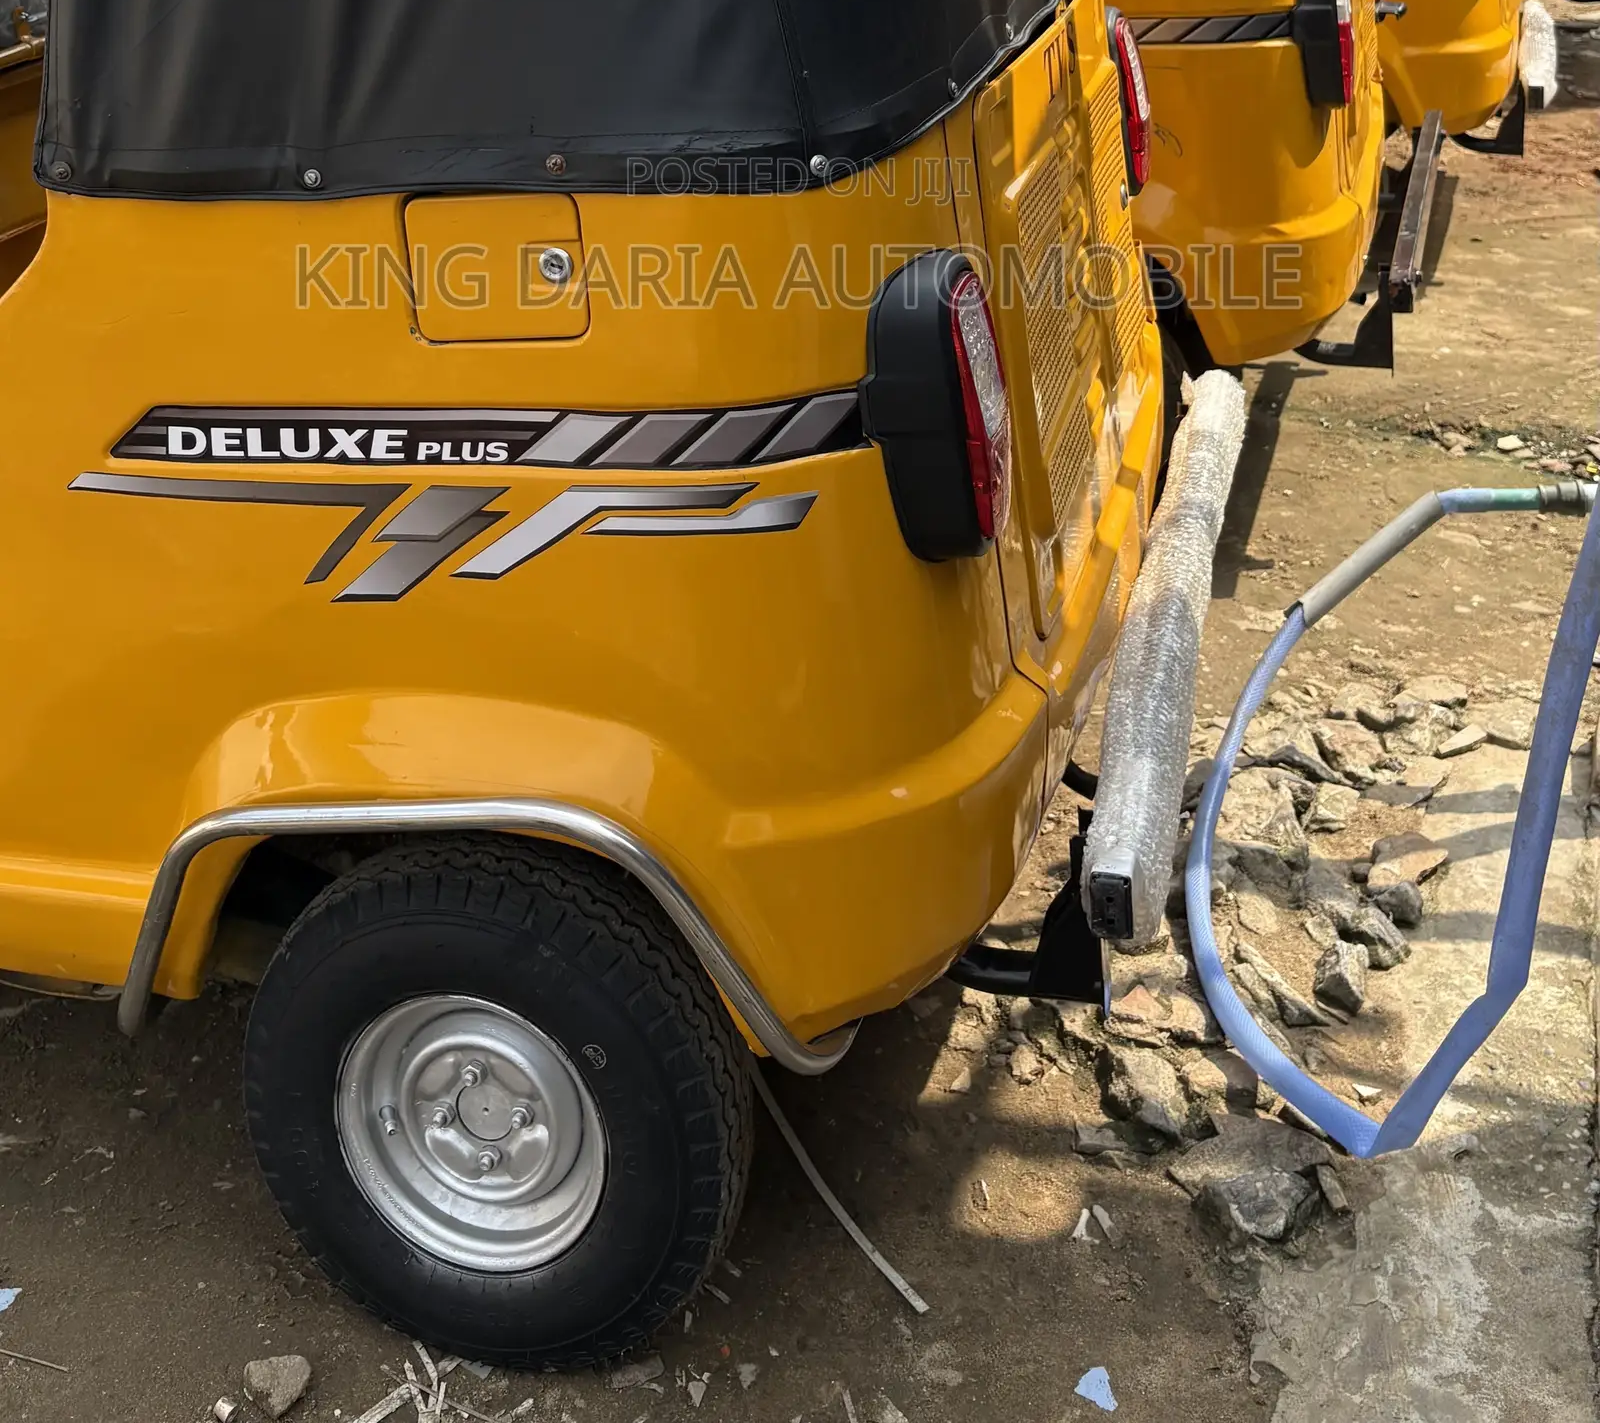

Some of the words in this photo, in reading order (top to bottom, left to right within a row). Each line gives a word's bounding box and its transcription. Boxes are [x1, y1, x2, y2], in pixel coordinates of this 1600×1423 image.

[1043, 22, 1076, 104] TVS
[166, 425, 408, 459] DELUXE
[416, 441, 509, 462] PLUS
